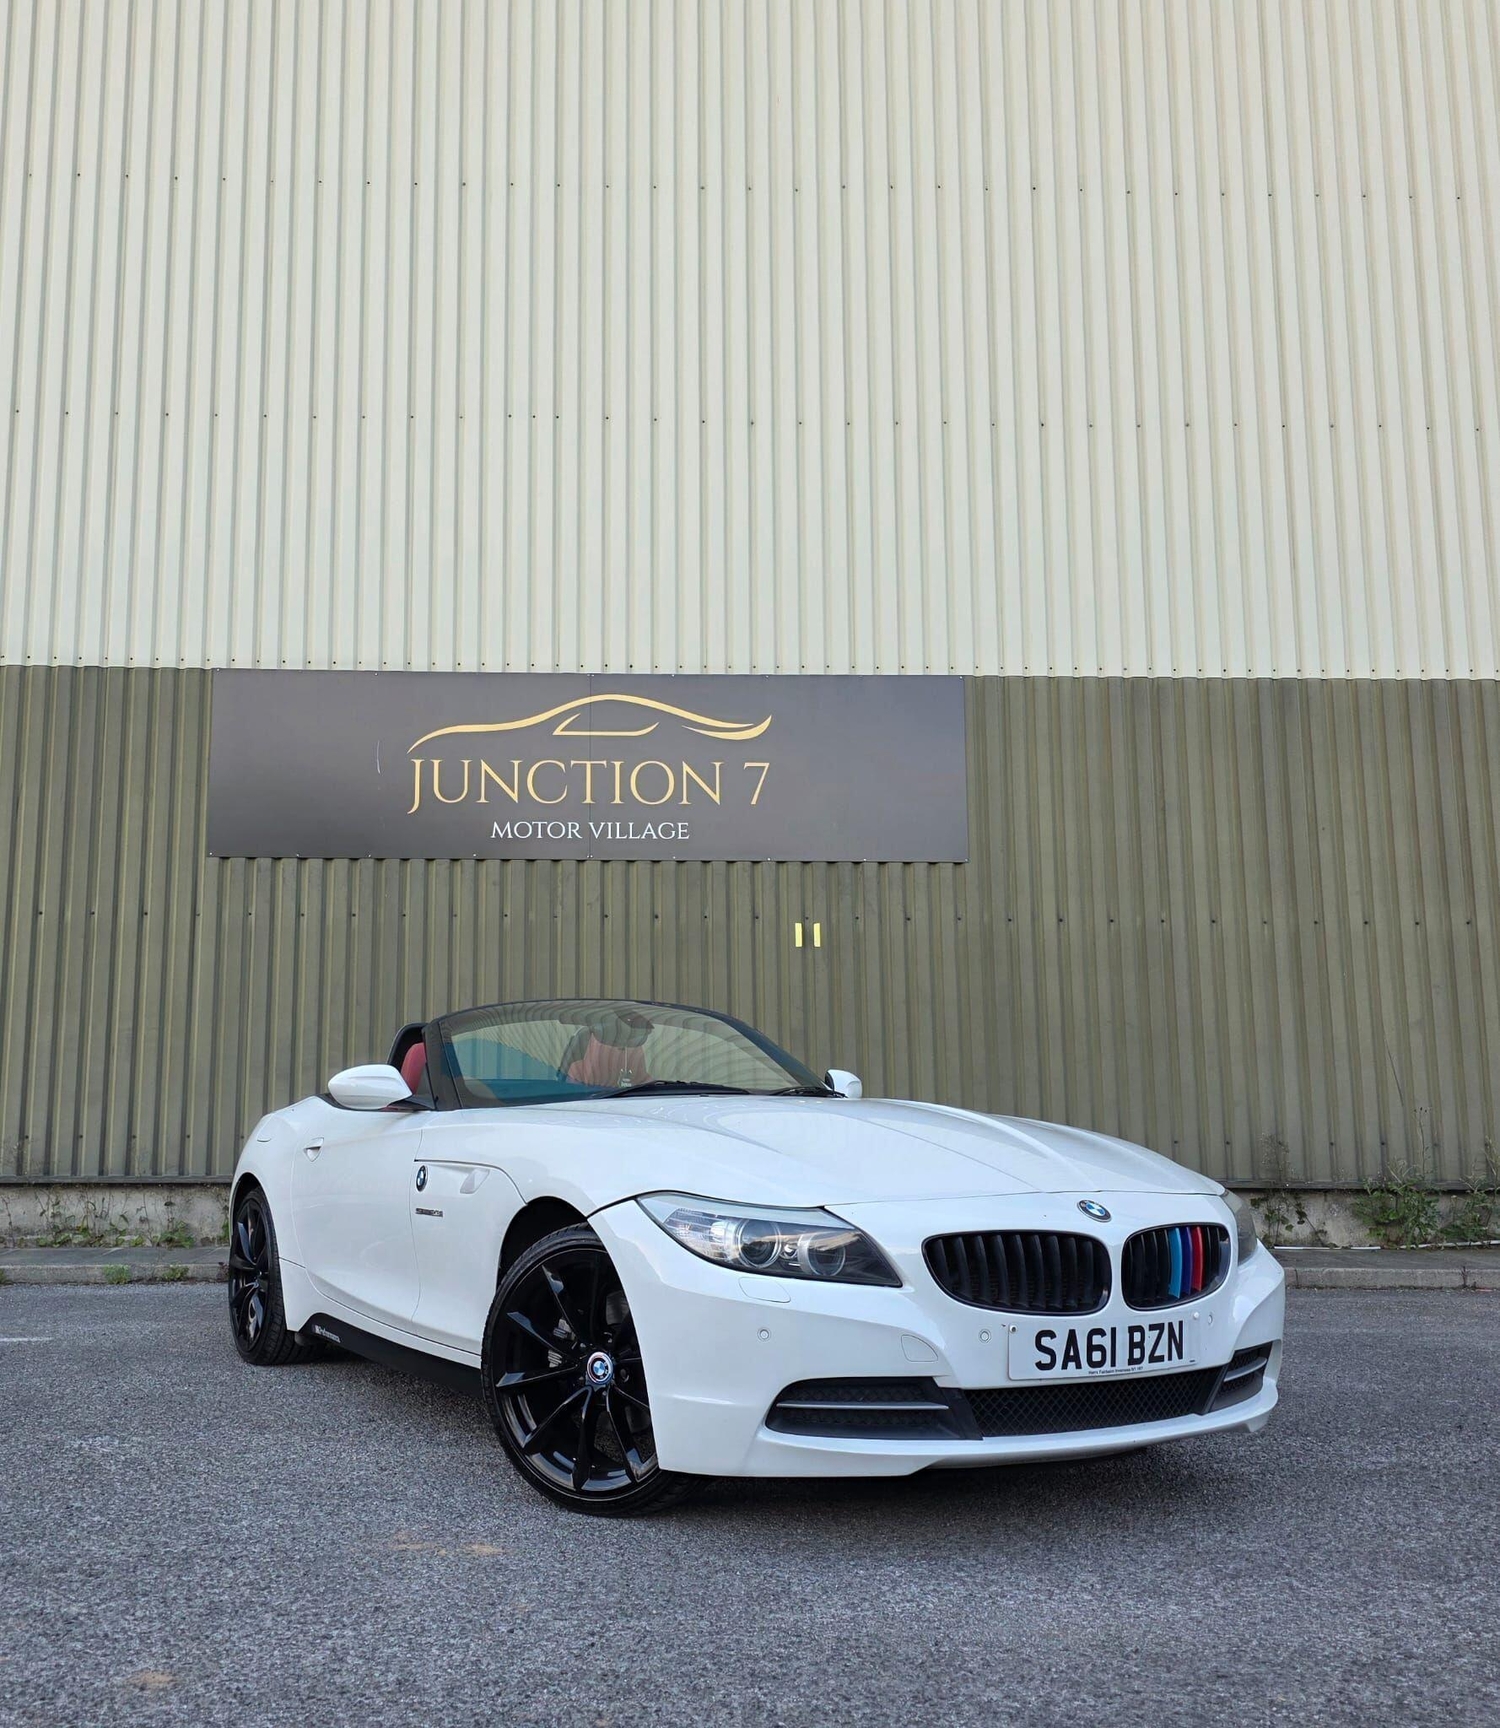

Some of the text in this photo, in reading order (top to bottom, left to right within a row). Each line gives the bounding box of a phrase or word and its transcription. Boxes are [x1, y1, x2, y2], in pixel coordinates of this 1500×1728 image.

[407, 758, 770, 815] JUNCTION 7
[490, 820, 691, 840] MOTOR VILLAGE
[1034, 1319, 1185, 1371] SA61 BZN
